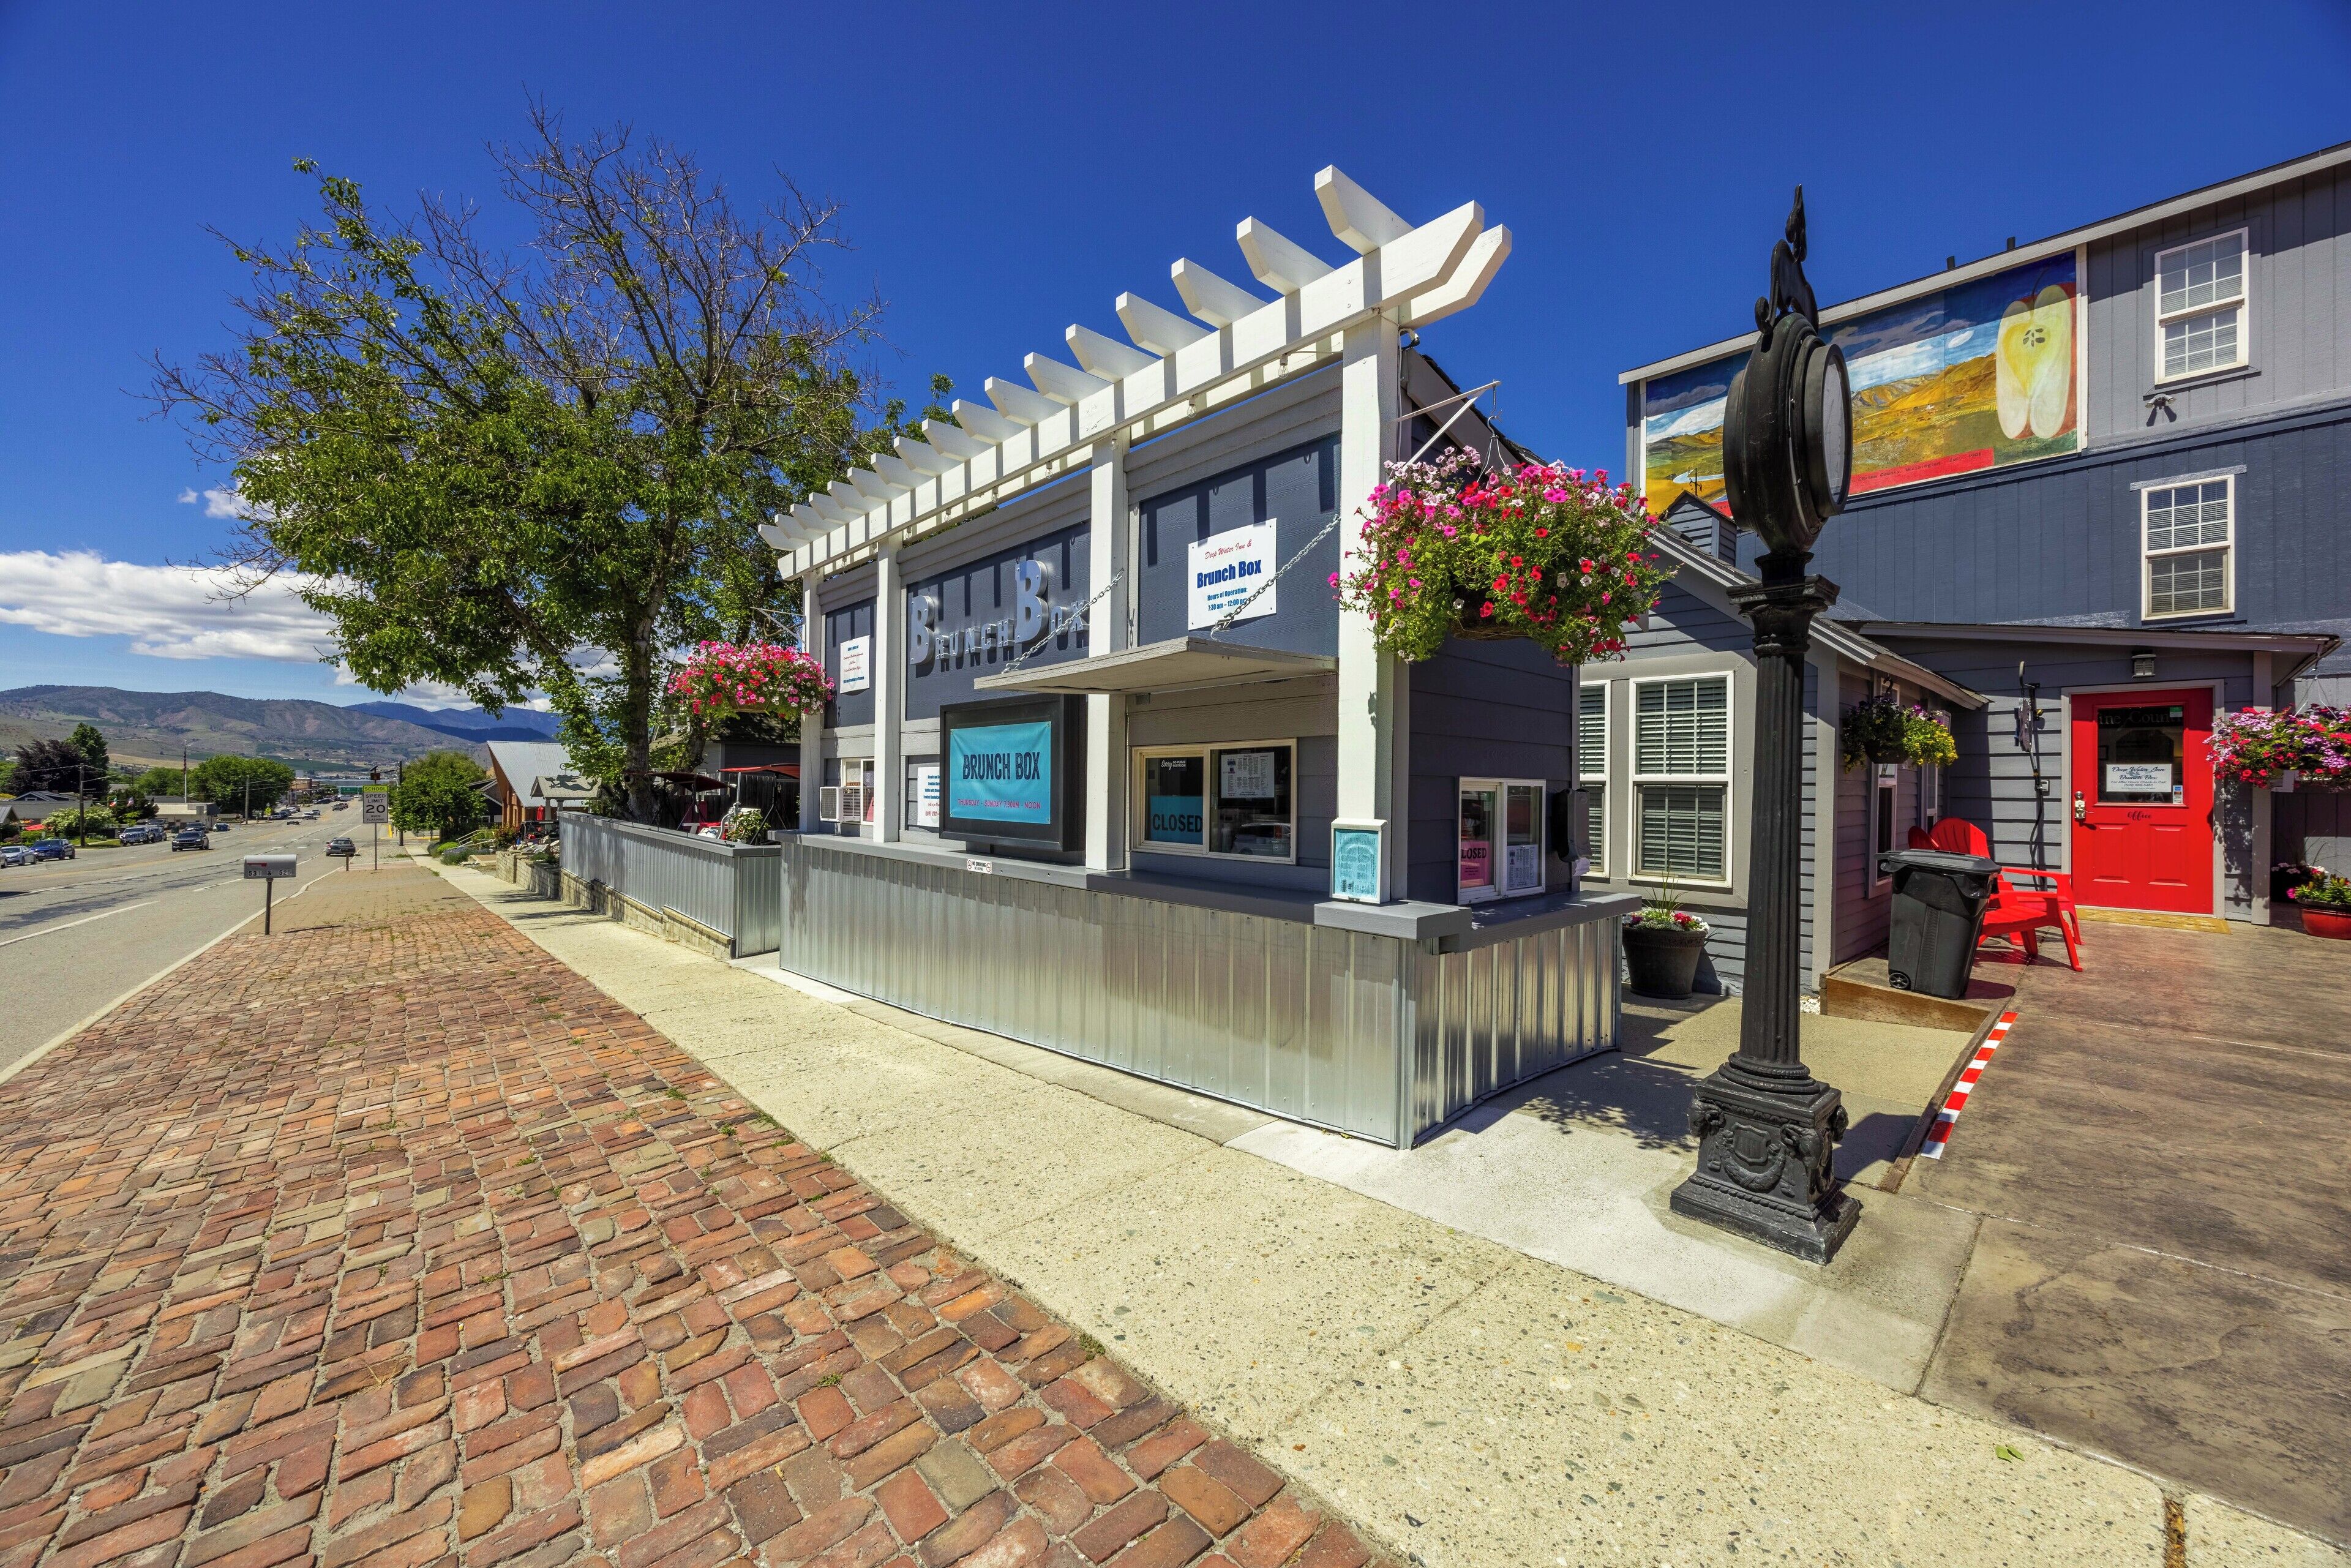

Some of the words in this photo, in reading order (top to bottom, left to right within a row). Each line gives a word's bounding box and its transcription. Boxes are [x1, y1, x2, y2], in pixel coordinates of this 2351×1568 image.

[1204, 551, 1217, 560] Deep
[1218, 546, 1234, 555] Water
[1247, 539, 1252, 547] &
[1197, 563, 1235, 589] Brunch
[1238, 559, 1262, 579] Box
[1224, 587, 1248, 598] Operation:
[1207, 603, 1217, 612] 7:30
[1227, 598, 1240, 607] 12:00
[962, 752, 1010, 780] BRUNCH
[1015, 751, 1040, 781] BOX
[1161, 760, 1173, 771] Sorry
[366, 805, 386, 814] 20
[958, 798, 980, 807] THURSDAY
[984, 800, 1002, 808] SUNDAY
[1152, 813, 1203, 833] CLOSED
[1461, 847, 1487, 859] LOSED
